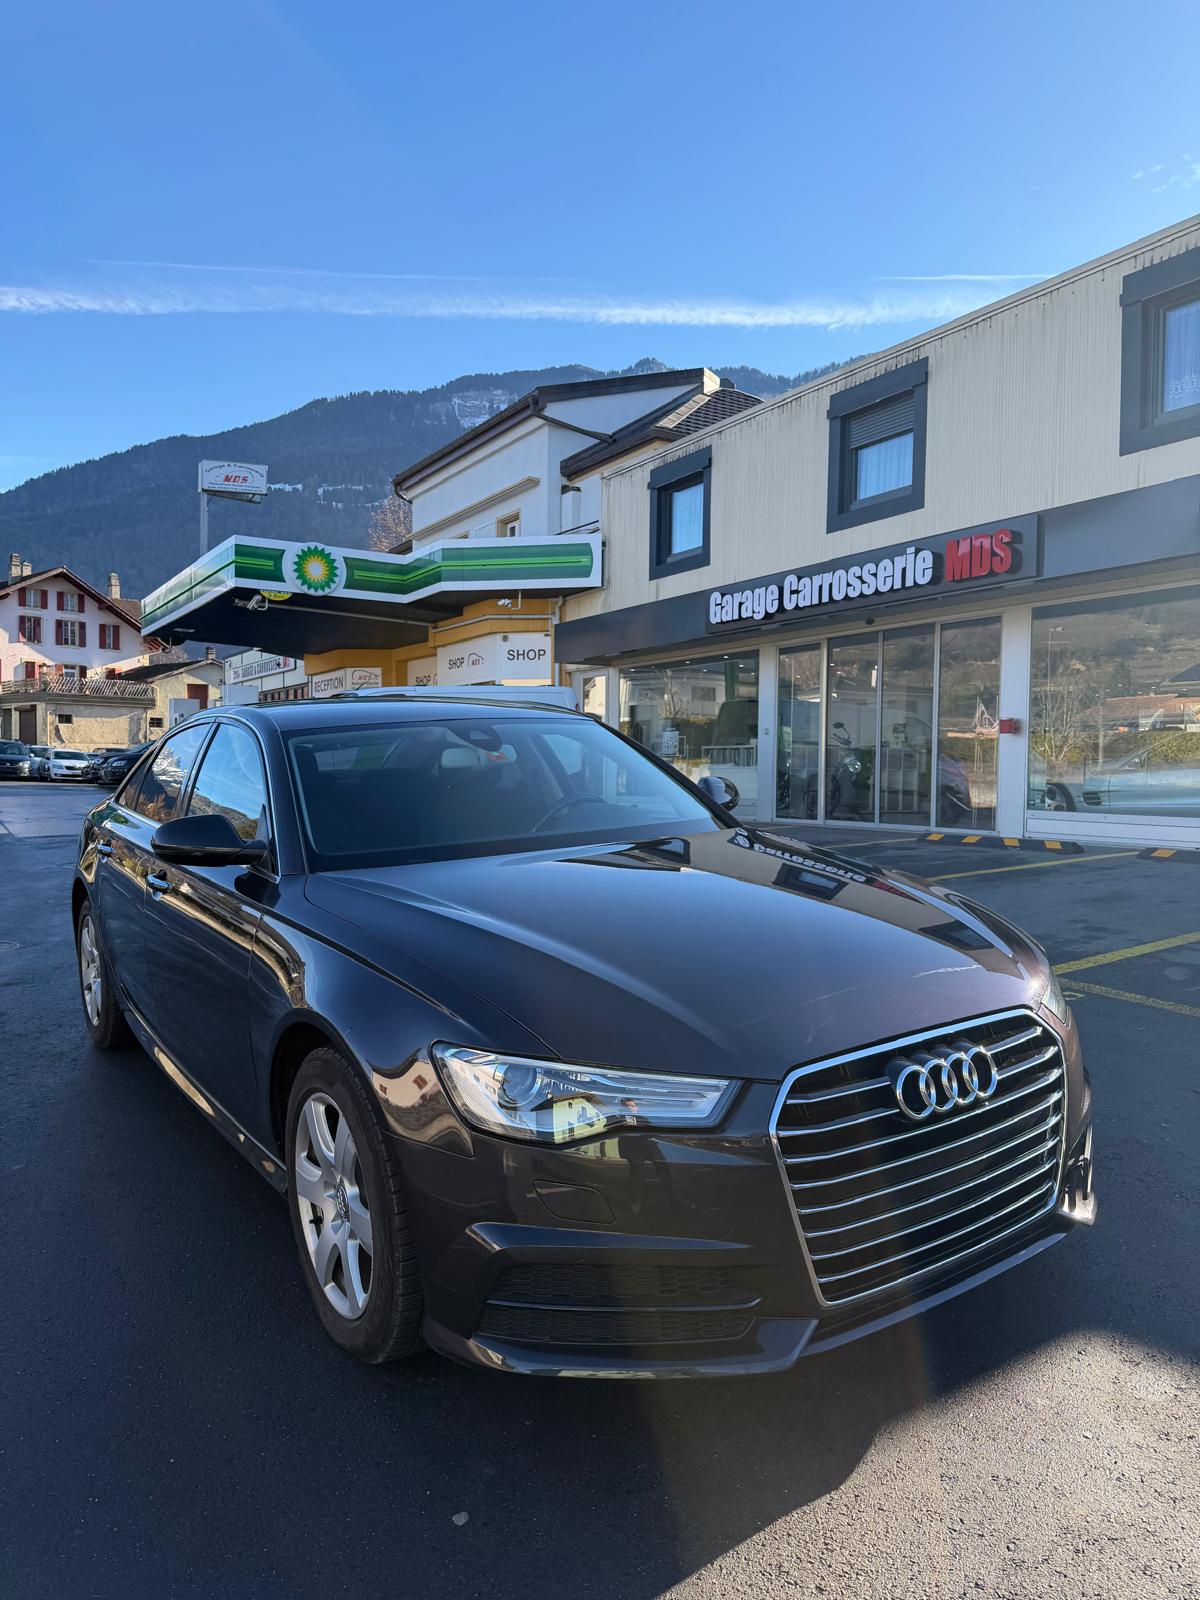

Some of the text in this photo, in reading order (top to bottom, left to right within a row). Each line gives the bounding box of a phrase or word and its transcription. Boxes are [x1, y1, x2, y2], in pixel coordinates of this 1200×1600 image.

[224, 474, 249, 484] MDS
[709, 528, 1012, 625] Garage Carrosserie MDS
[507, 649, 546, 661] SHOP
[448, 657, 465, 670] SHOP
[314, 676, 344, 693] RECEPTION
[415, 675, 431, 686] SHOP
